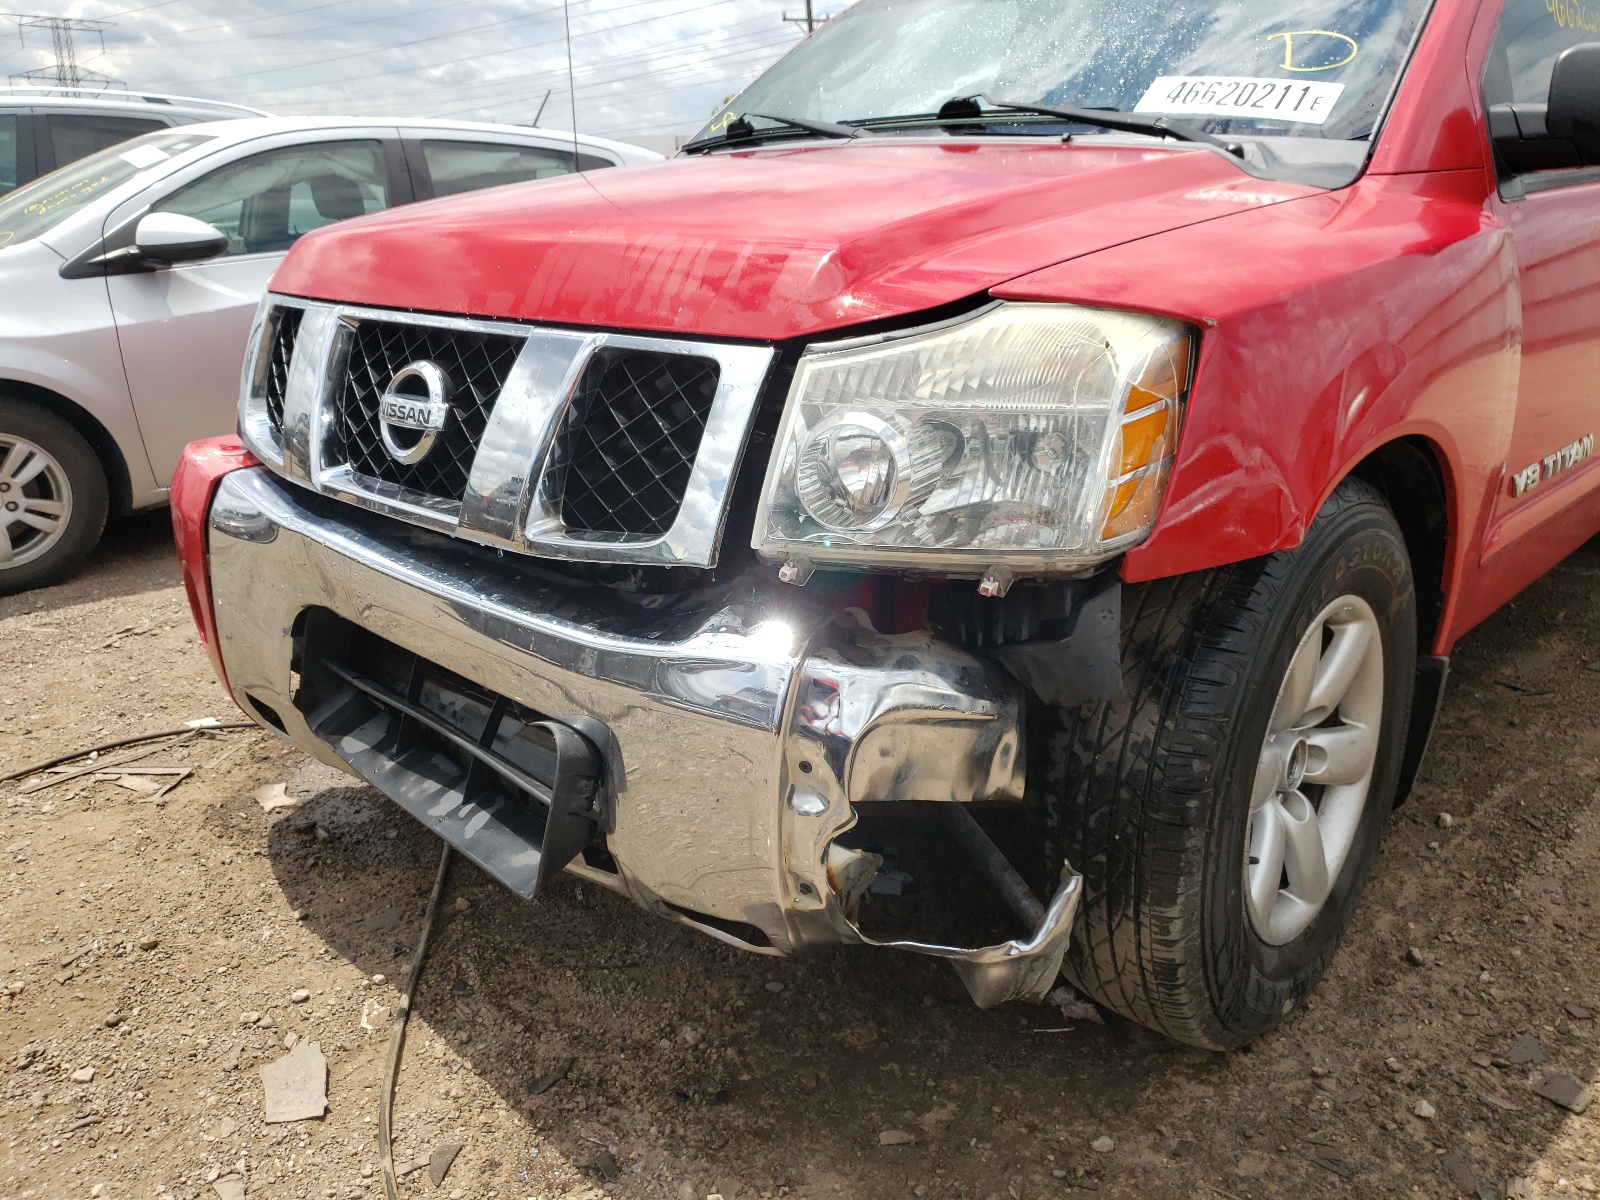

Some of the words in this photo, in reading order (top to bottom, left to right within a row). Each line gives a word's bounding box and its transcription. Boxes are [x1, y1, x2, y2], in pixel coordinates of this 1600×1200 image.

[1266, 30, 1358, 72] D
[1167, 81, 1311, 112] 46620211
[380, 400, 432, 425] NISSAN
[1511, 462, 1540, 498] V8
[1542, 432, 1594, 481] TITAN
